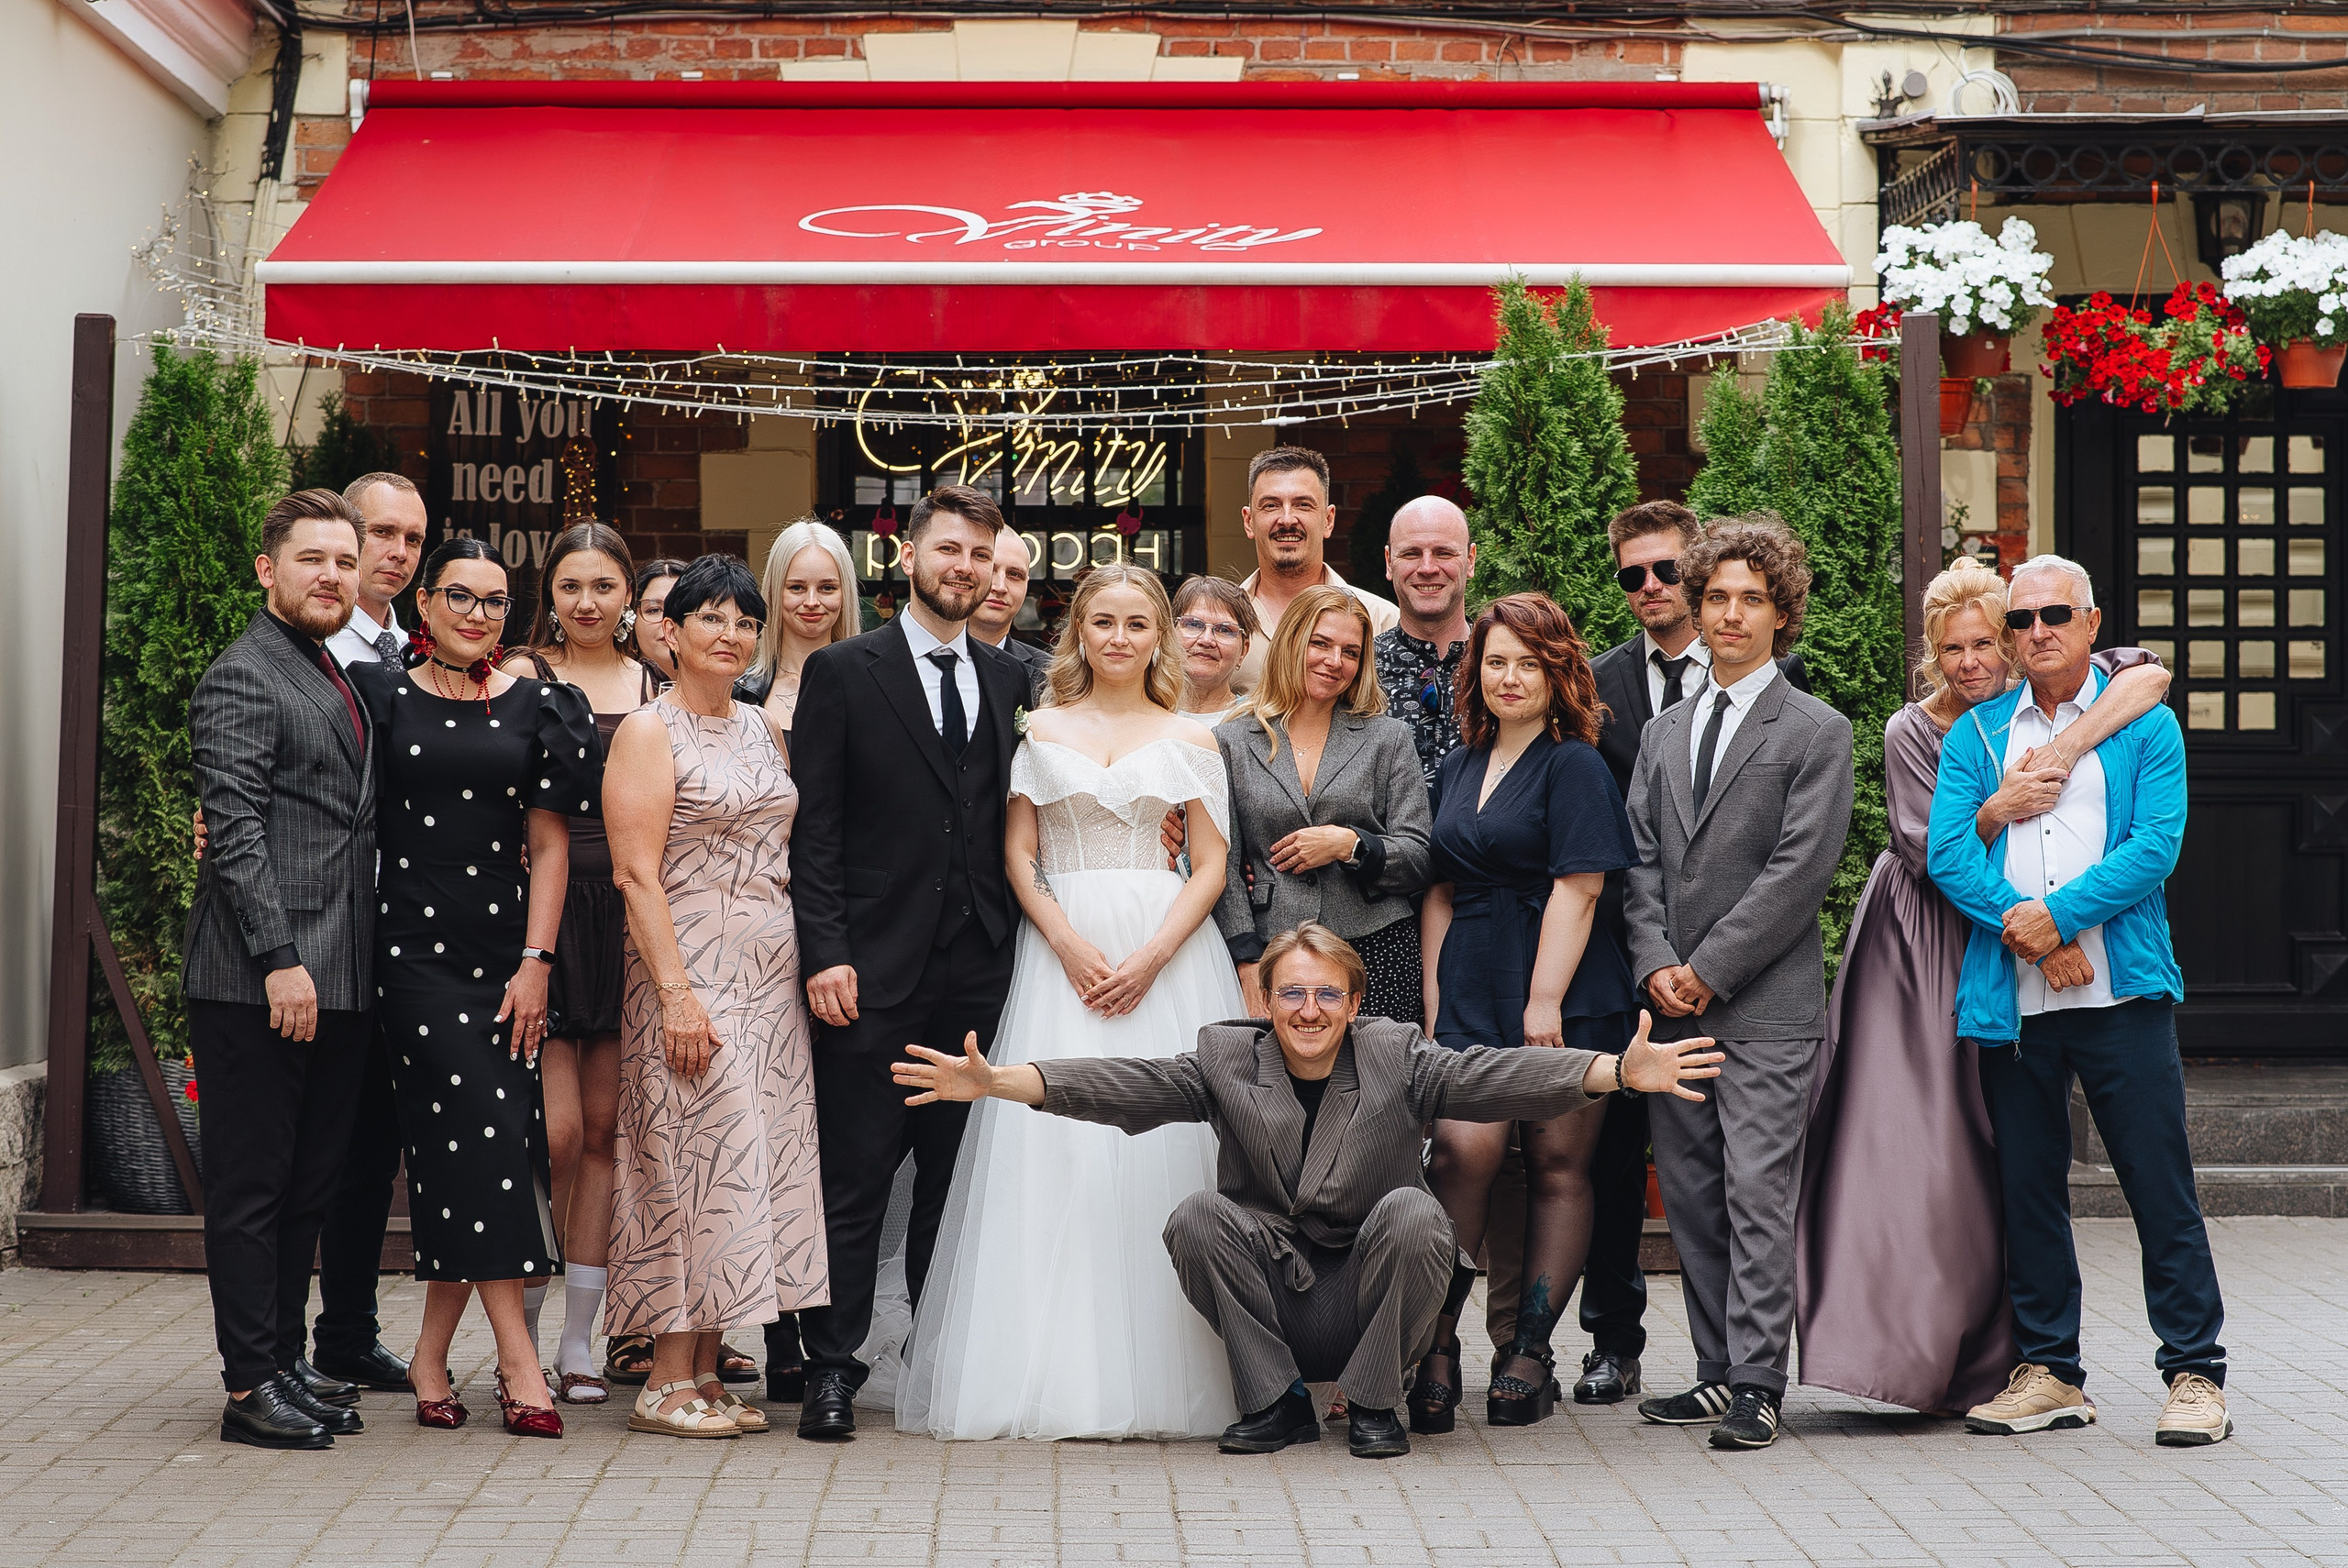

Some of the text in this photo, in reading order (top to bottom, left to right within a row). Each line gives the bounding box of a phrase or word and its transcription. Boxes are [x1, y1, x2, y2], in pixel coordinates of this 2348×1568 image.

[447, 391, 593, 444] All you
[452, 458, 554, 504] need
[489, 523, 563, 569] lov
